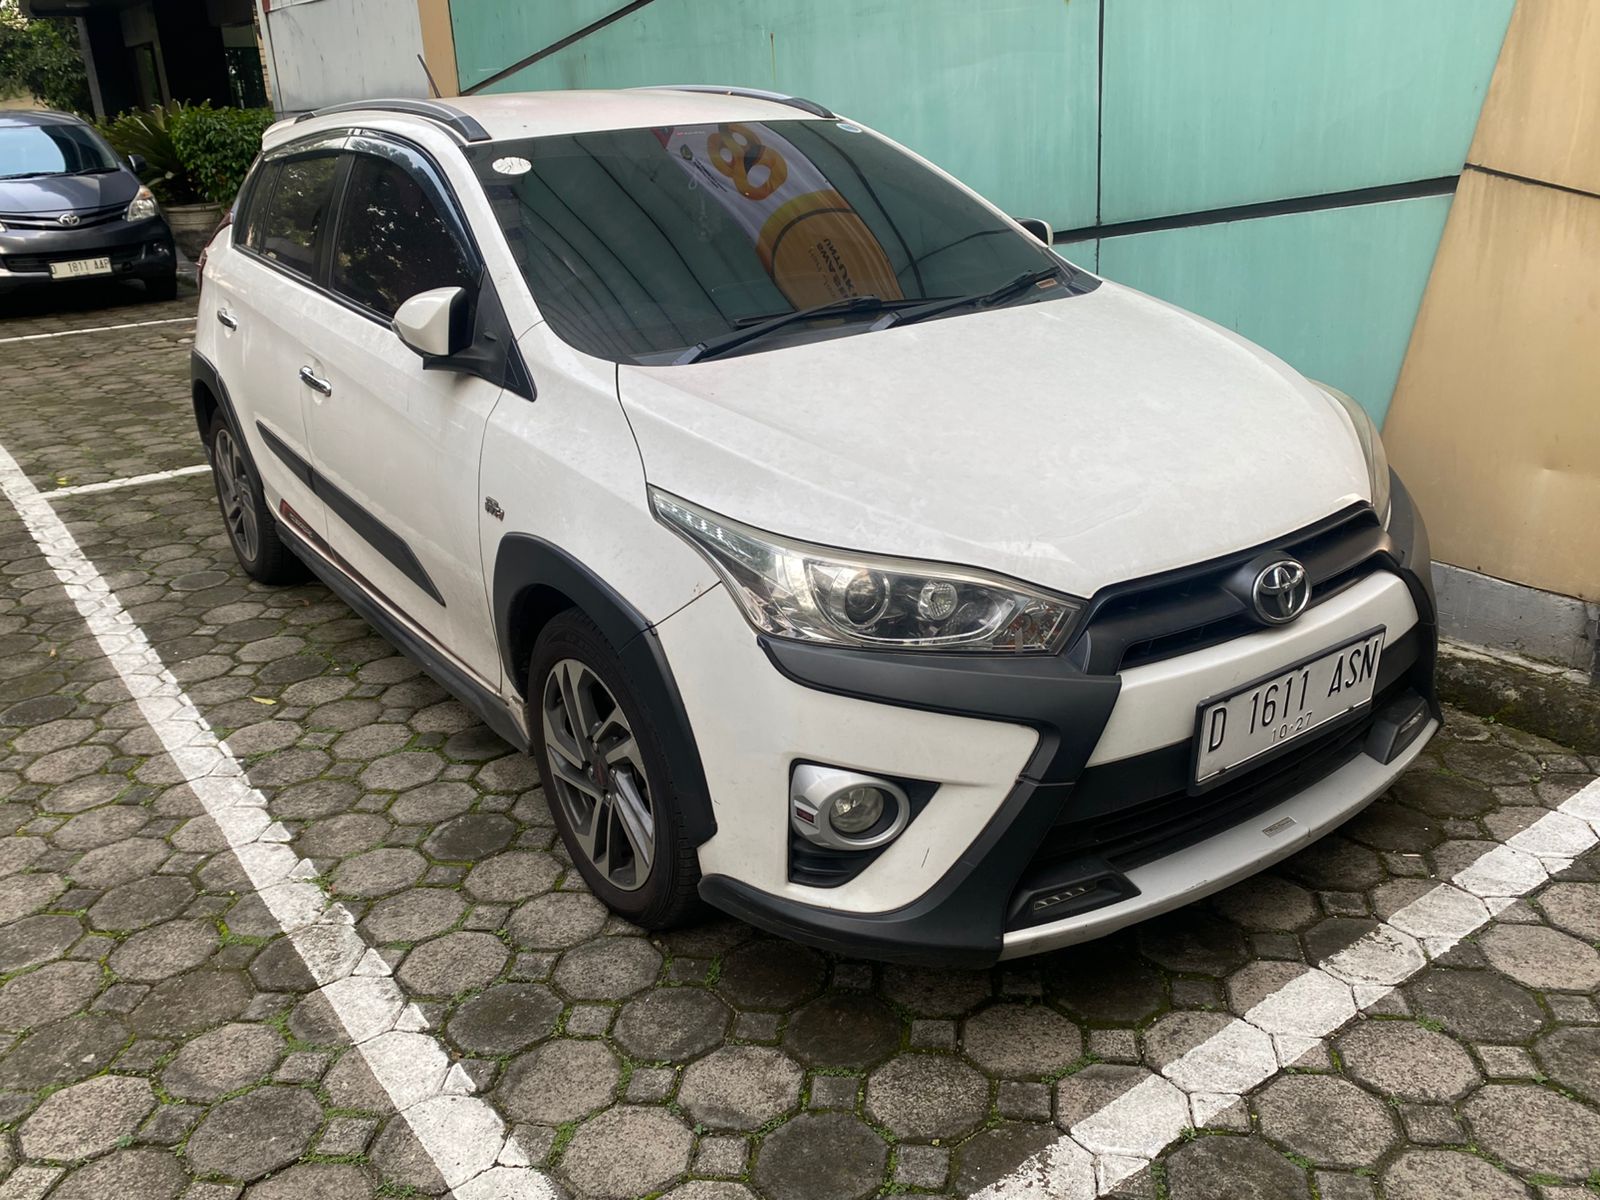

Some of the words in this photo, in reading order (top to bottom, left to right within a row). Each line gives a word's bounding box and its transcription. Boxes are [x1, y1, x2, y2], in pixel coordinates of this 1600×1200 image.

[67, 261, 89, 273] 1811
[1208, 706, 1227, 753] D
[1249, 670, 1310, 735] 1611
[1327, 638, 1379, 697] ASN
